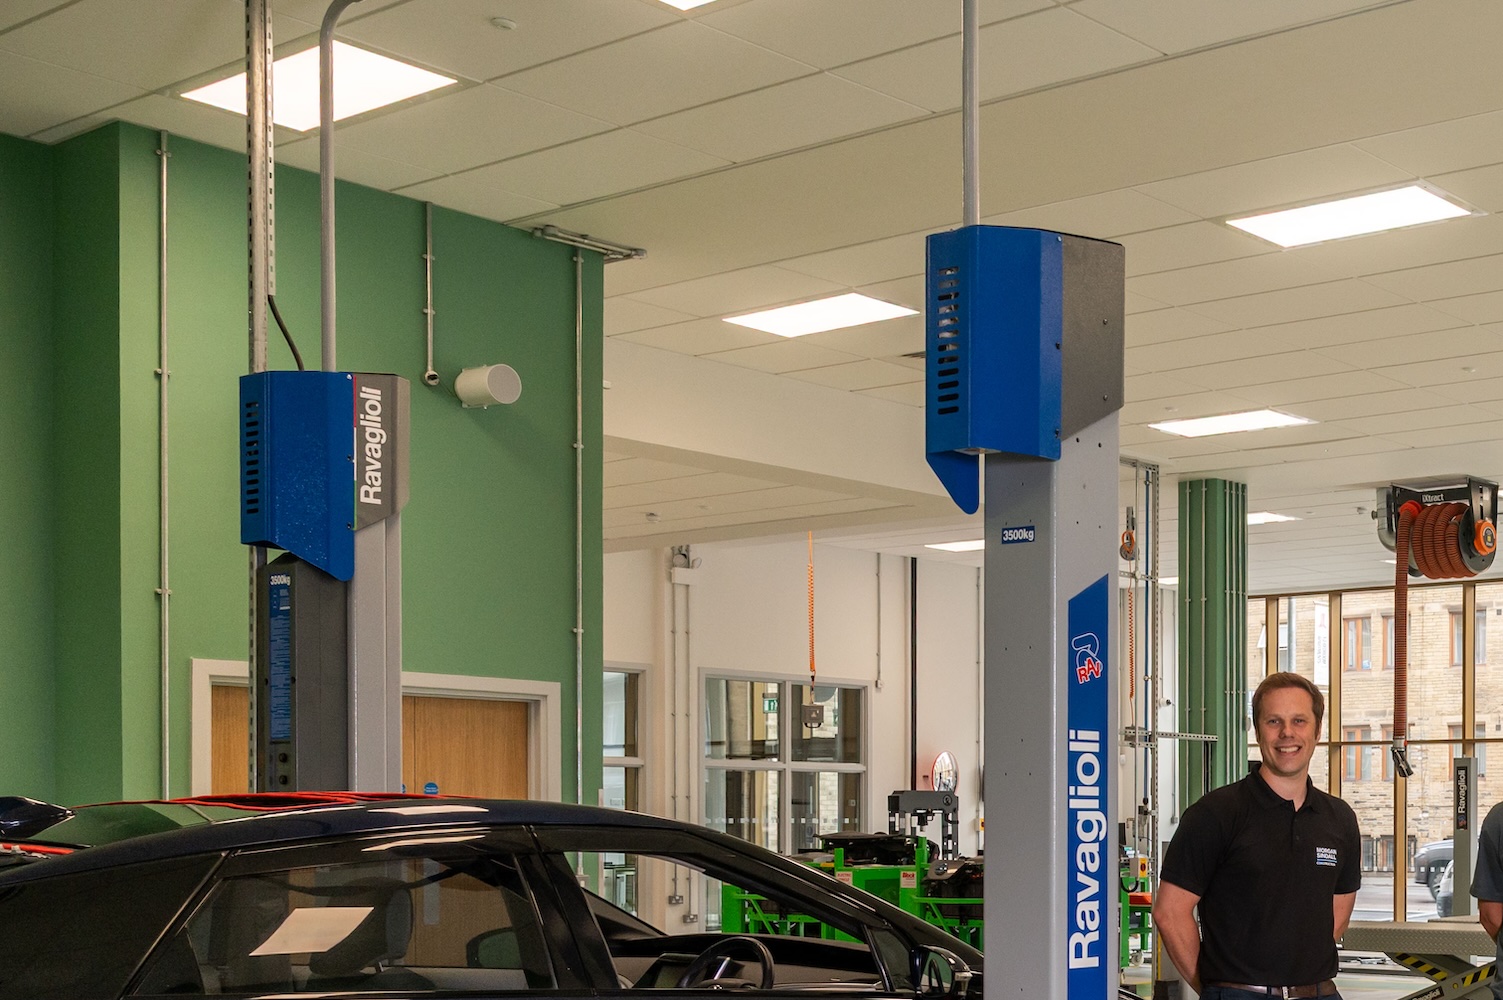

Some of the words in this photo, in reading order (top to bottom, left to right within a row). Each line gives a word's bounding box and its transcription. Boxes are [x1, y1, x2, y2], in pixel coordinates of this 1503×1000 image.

[360, 386, 387, 505] Ravaglioli
[1003, 528, 1034, 541] 3500kg
[1077, 657, 1101, 684] RAV
[1458, 768, 1467, 814] Ravaglioli
[1068, 729, 1107, 969] Ravaglioli
[1316, 847, 1337, 855] MORGAN
[1316, 852, 1336, 860] SINDALL
